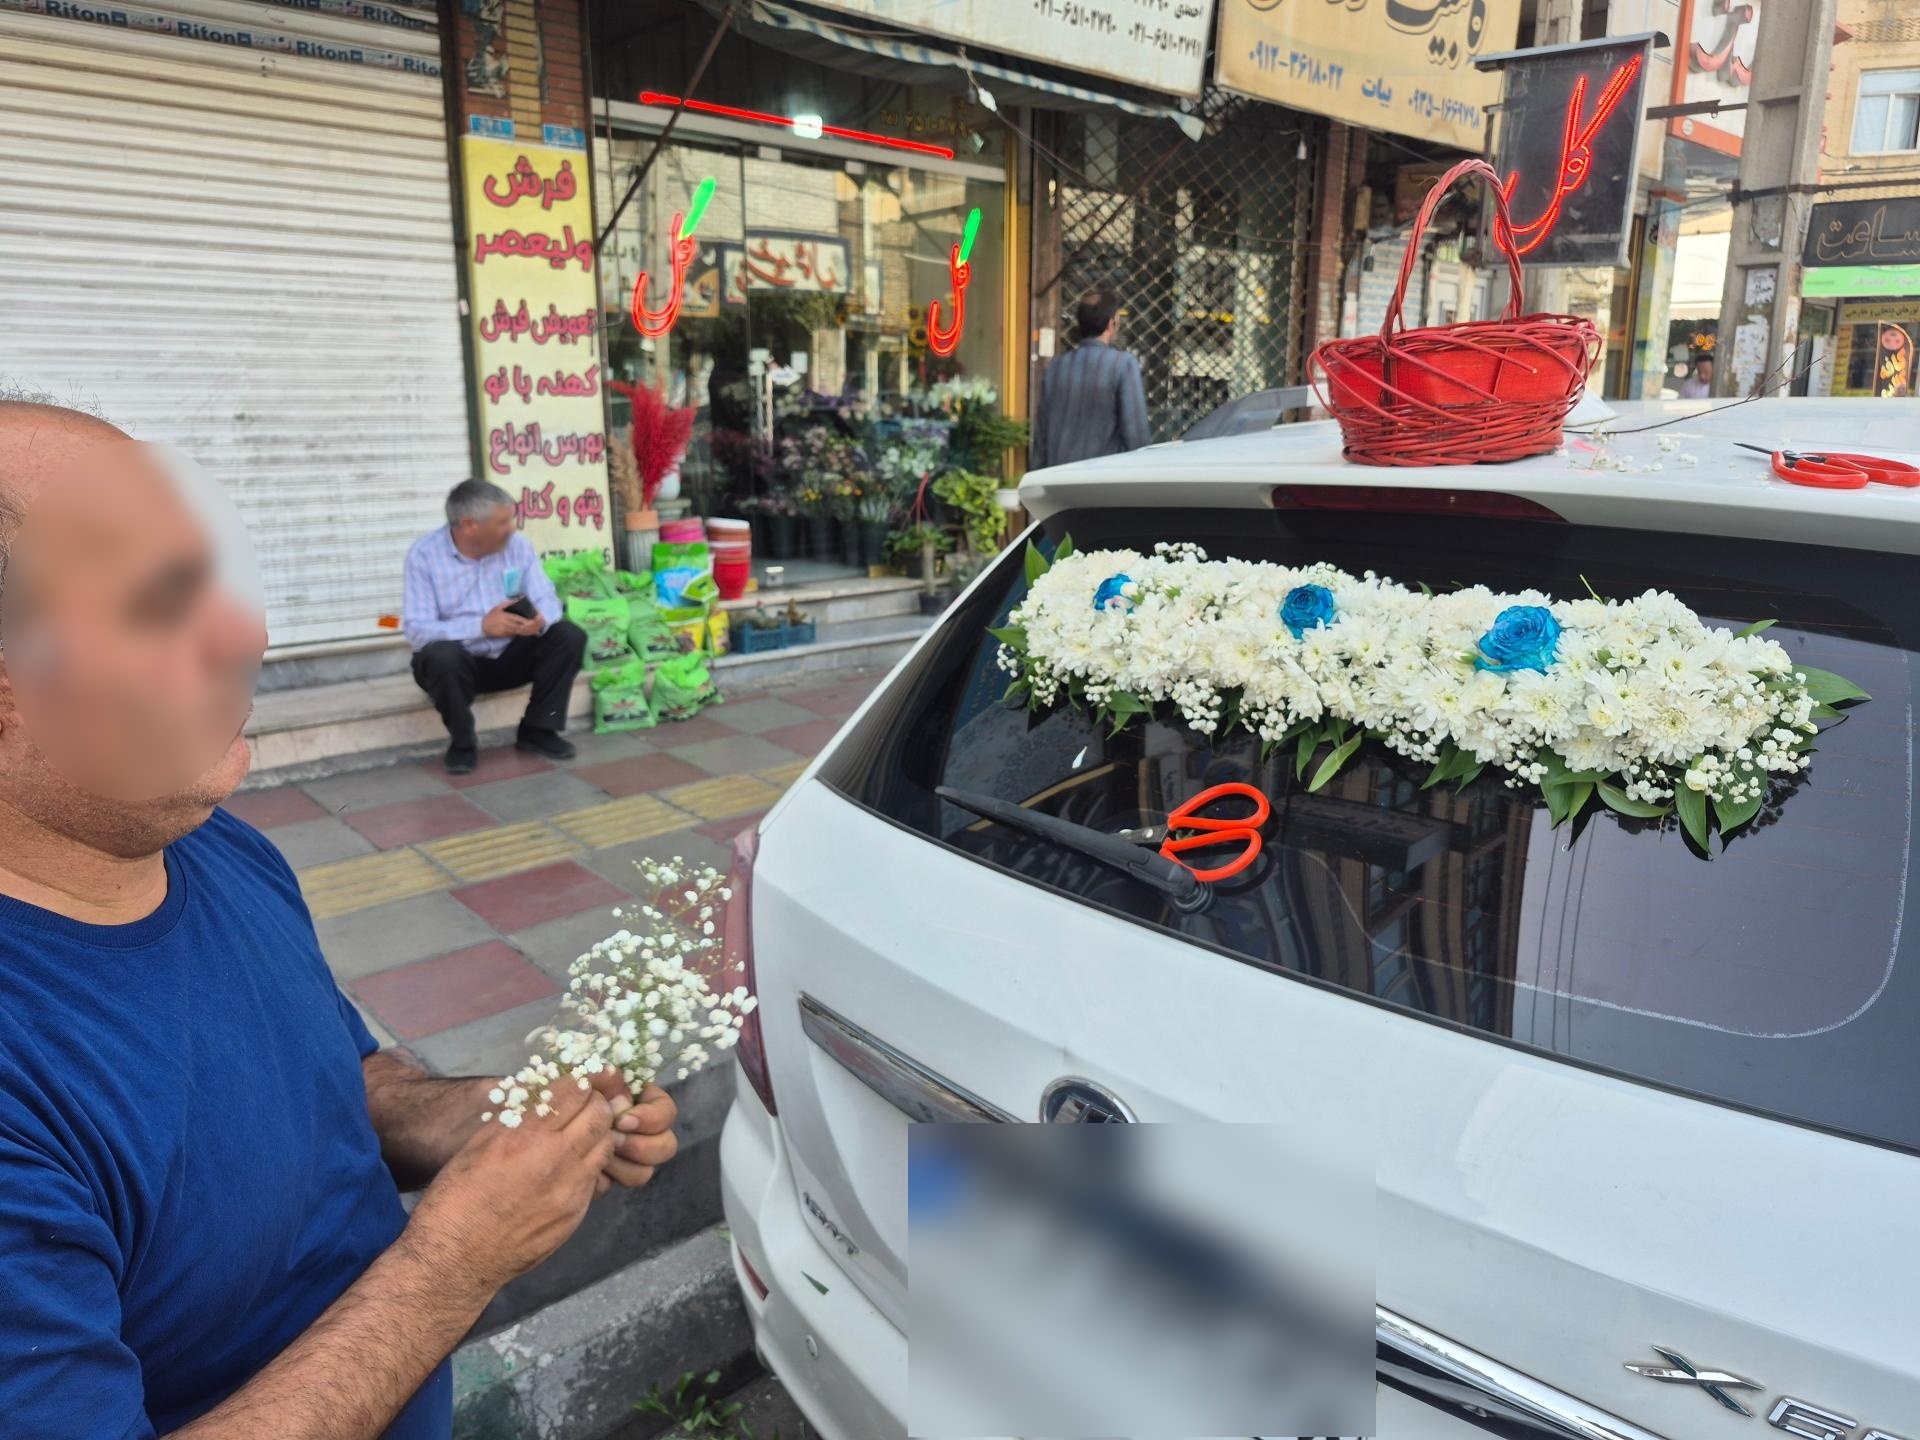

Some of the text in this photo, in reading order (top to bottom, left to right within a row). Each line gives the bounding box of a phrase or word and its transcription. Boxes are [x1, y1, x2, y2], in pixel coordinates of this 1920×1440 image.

[45, 0, 109, 25] Riton
[177, 21, 237, 45] Riton
[296, 40, 349, 62] Riton
[1494, 53, 1643, 256] گل
[483, 155, 578, 212] فرش
[475, 225, 595, 273] ولیعصر
[632, 176, 716, 339] گل
[927, 207, 982, 357] گل
[479, 298, 530, 344] فرش
[484, 364, 600, 404] کهنه با نو
[490, 422, 606, 474] بورس انواع
[513, 481, 605, 530] پتو و کنار
